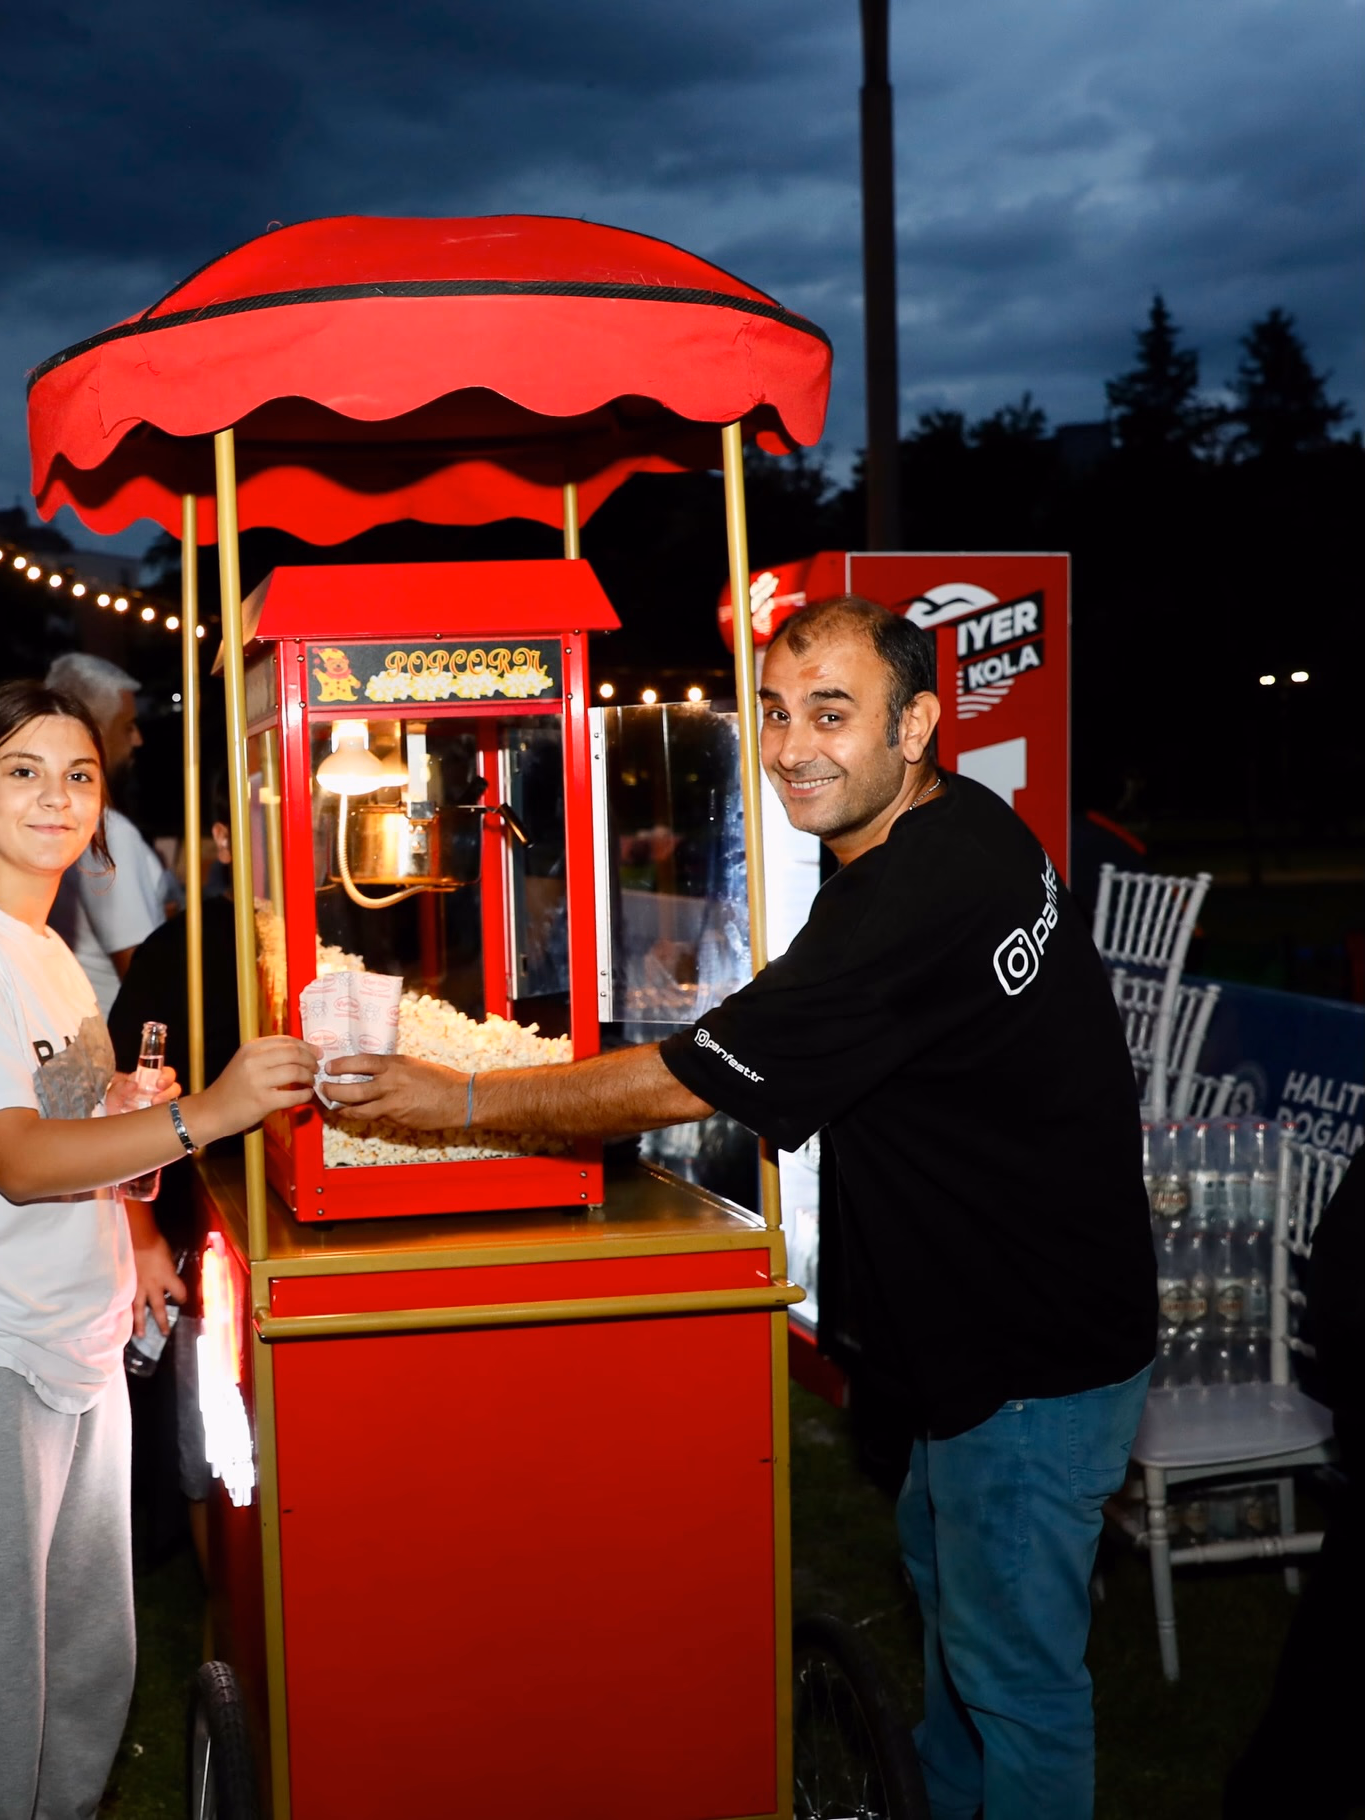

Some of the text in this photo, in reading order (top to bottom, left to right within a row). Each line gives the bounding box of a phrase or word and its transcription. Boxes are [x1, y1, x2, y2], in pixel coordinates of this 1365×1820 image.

[384, 647, 548, 678] POPCORN
[967, 644, 1041, 691] KOLA
[705, 1039, 765, 1083] panfest.tr
